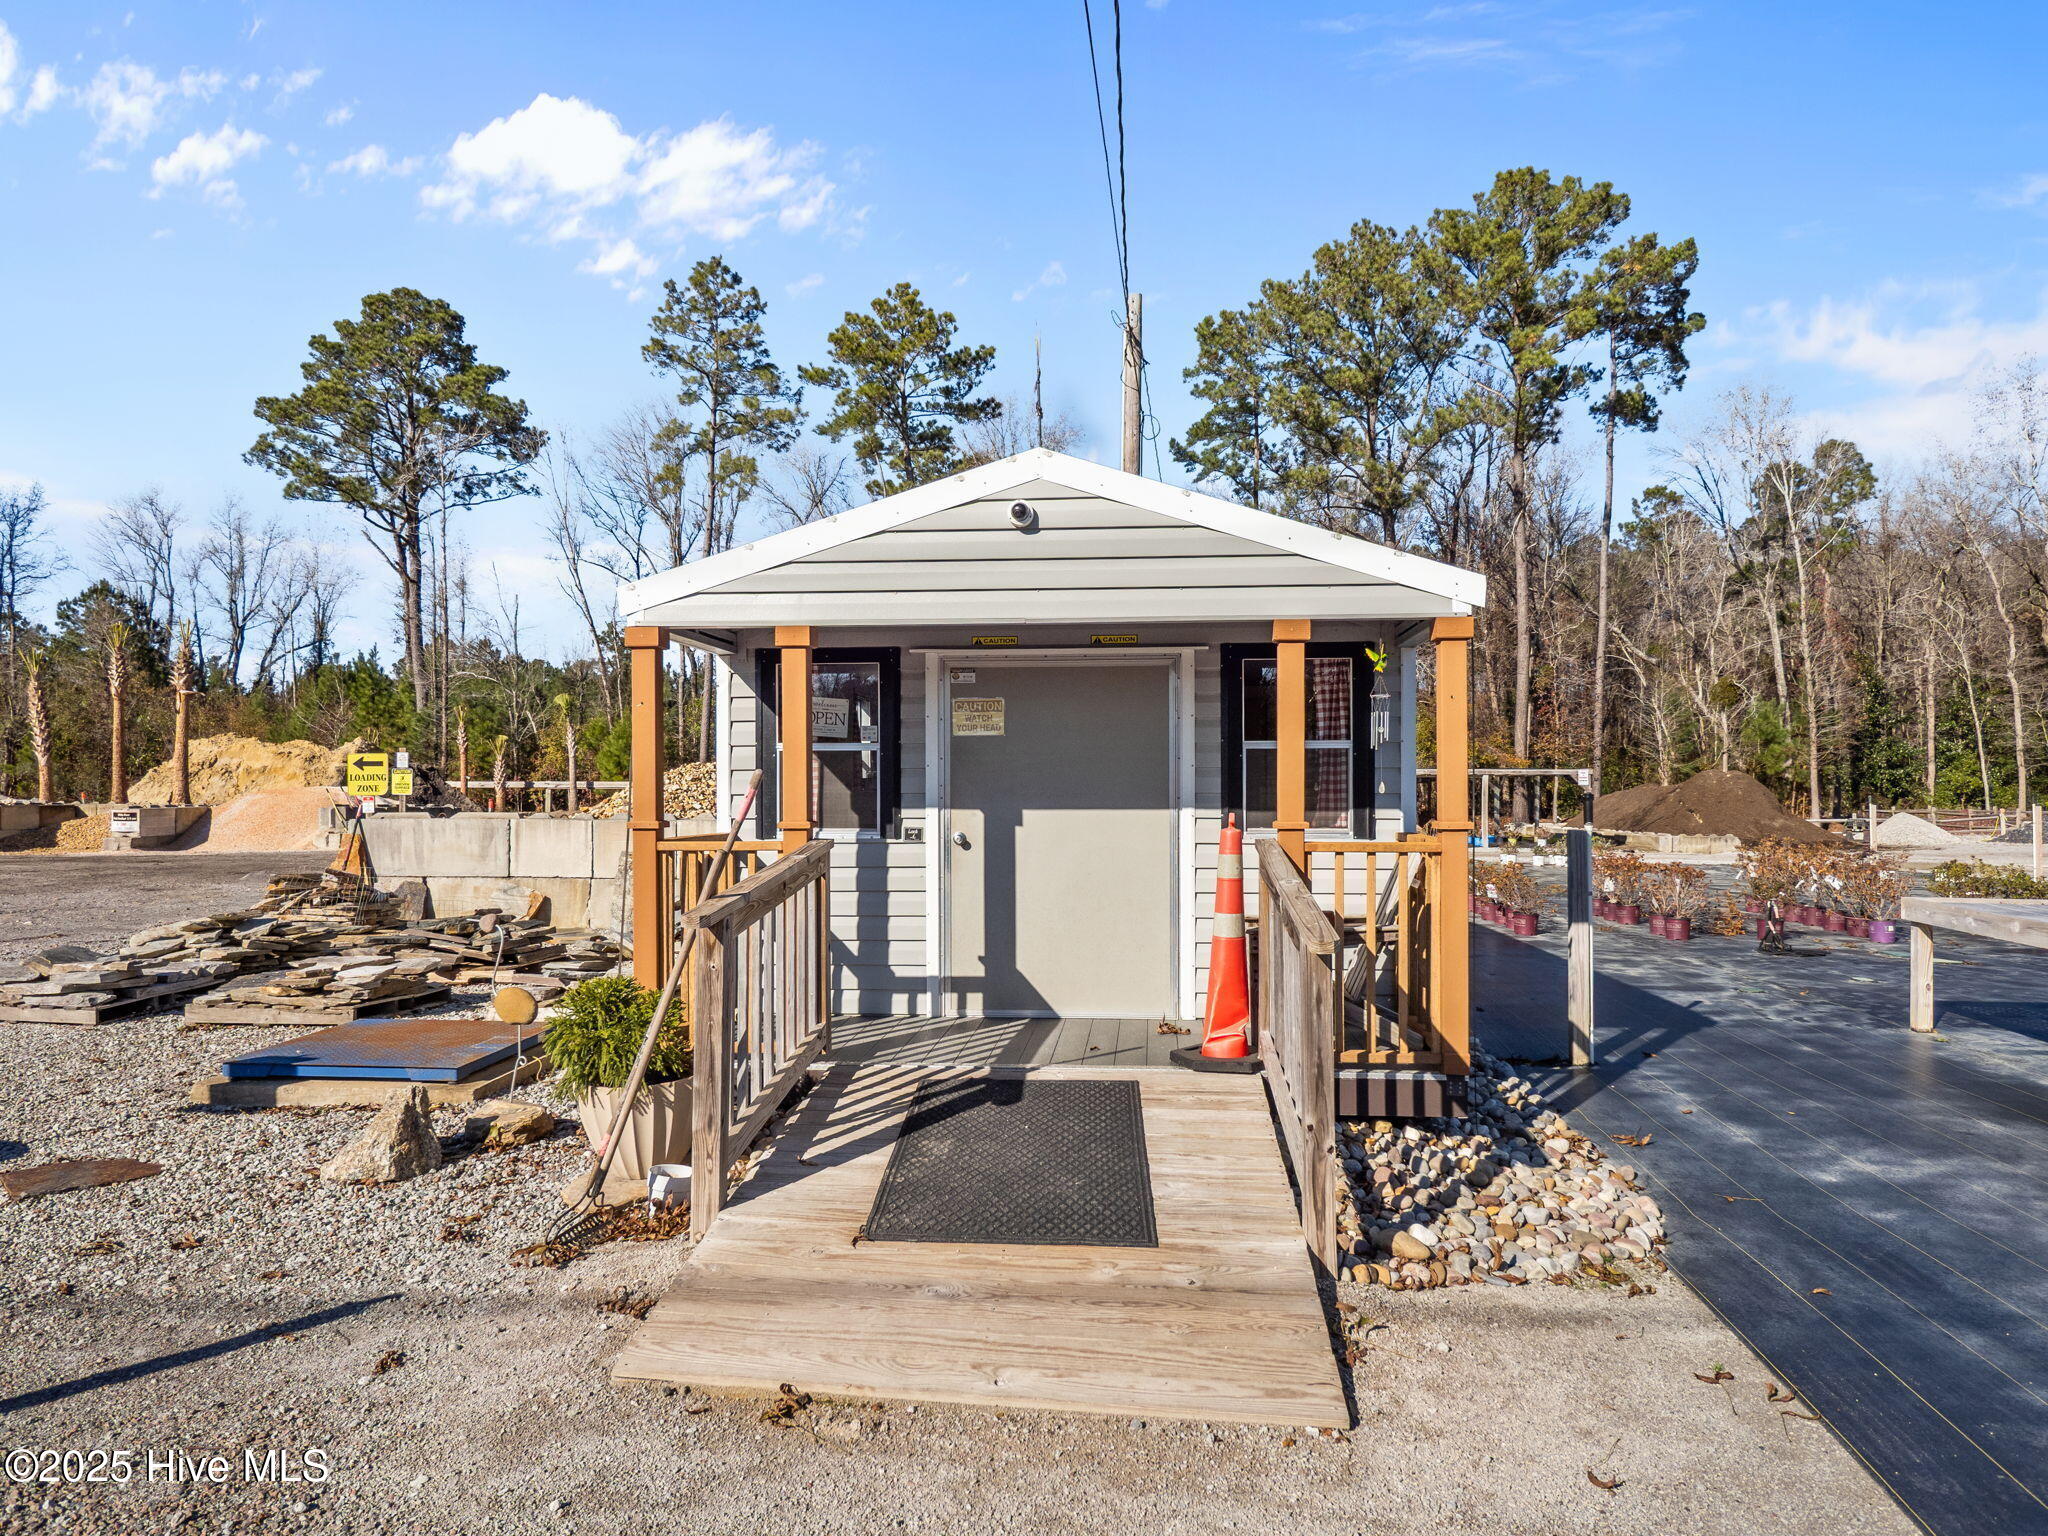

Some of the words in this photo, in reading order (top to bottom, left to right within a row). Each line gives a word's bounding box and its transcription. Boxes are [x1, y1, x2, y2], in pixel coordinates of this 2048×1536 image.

[955, 701, 1002, 711] CAUTION
[811, 711, 846, 726] PEN
[965, 714, 993, 722] WATCH
[956, 724, 978, 732] YOUR
[980, 723, 1002, 731] HEAD
[349, 773, 387, 782] LOADING
[357, 784, 380, 793] ZONE
